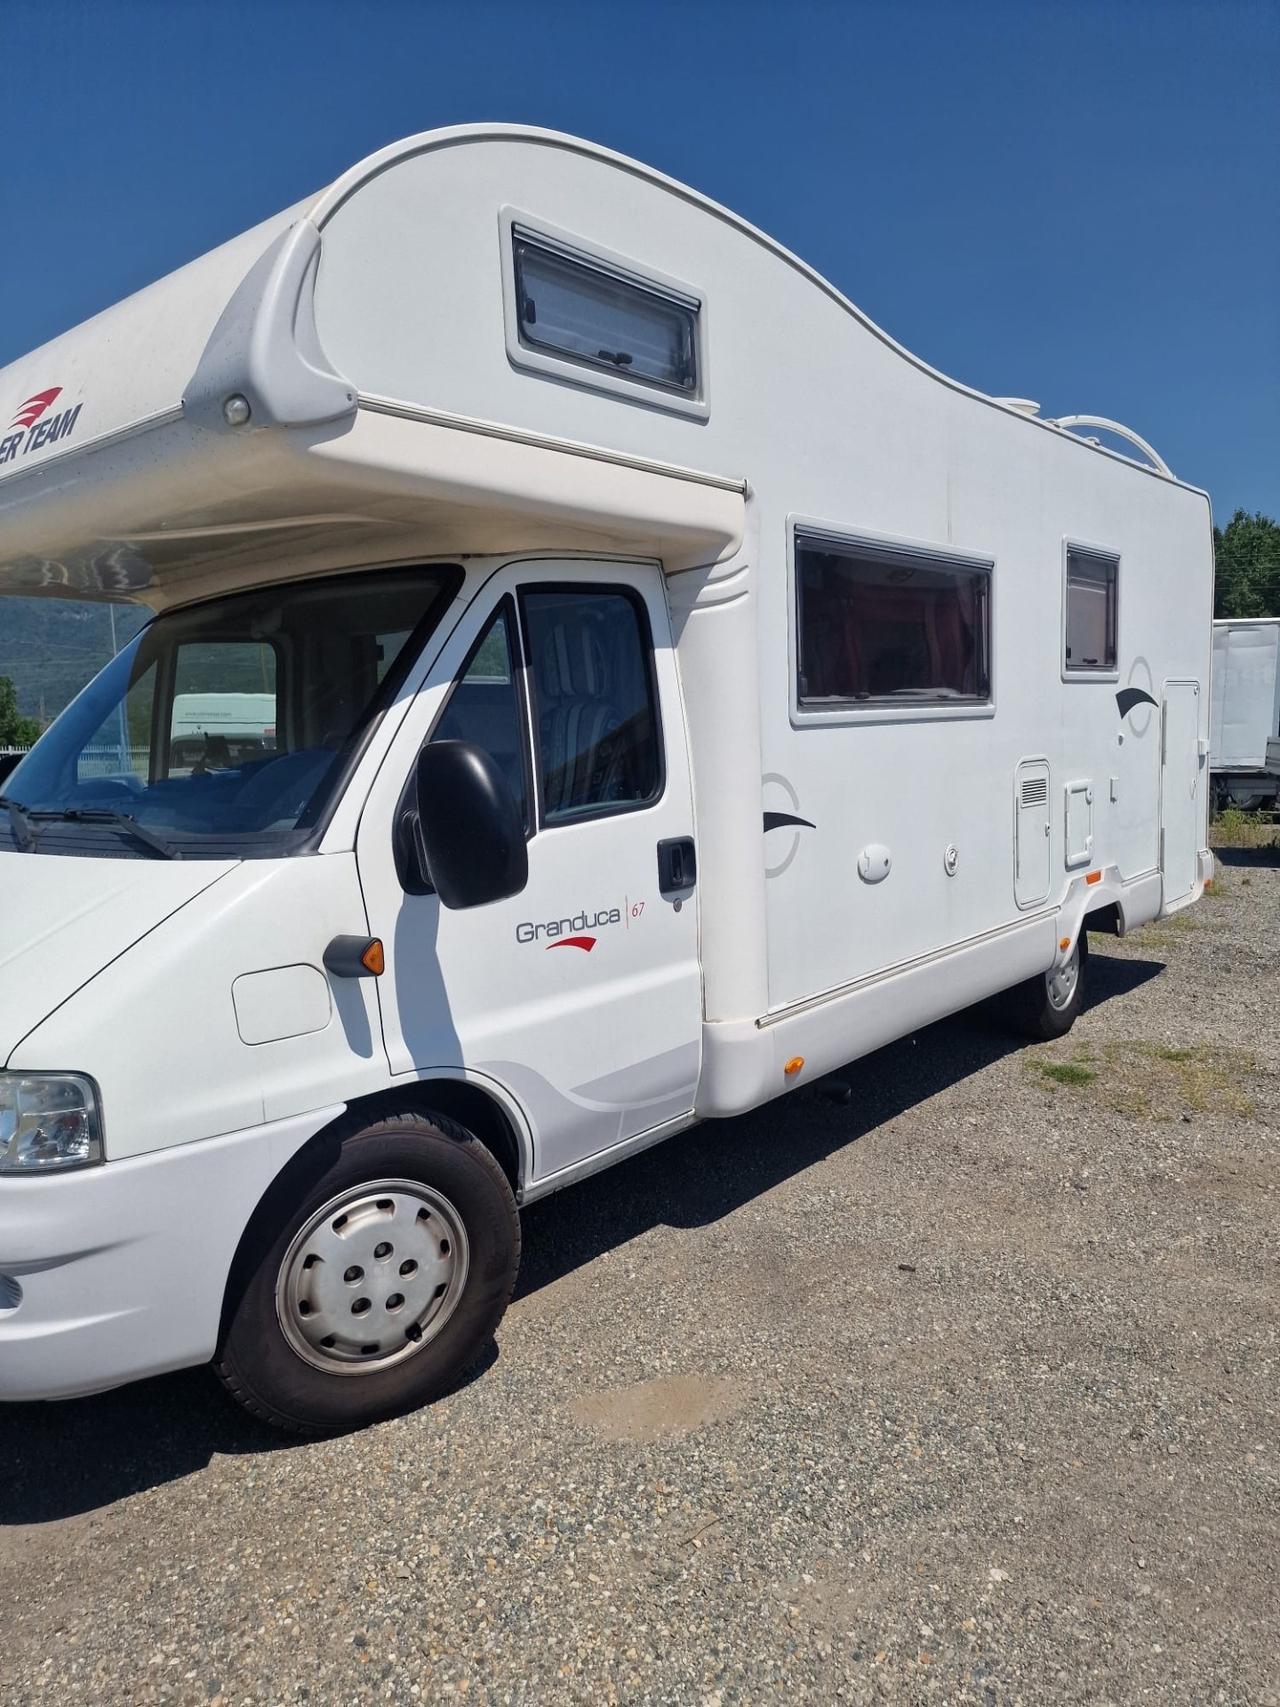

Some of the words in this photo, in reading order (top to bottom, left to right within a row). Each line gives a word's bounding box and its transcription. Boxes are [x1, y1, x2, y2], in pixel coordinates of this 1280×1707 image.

[23, 402, 84, 455] TEAM
[516, 908, 621, 944] Granduca
[631, 902, 645, 918] 67
